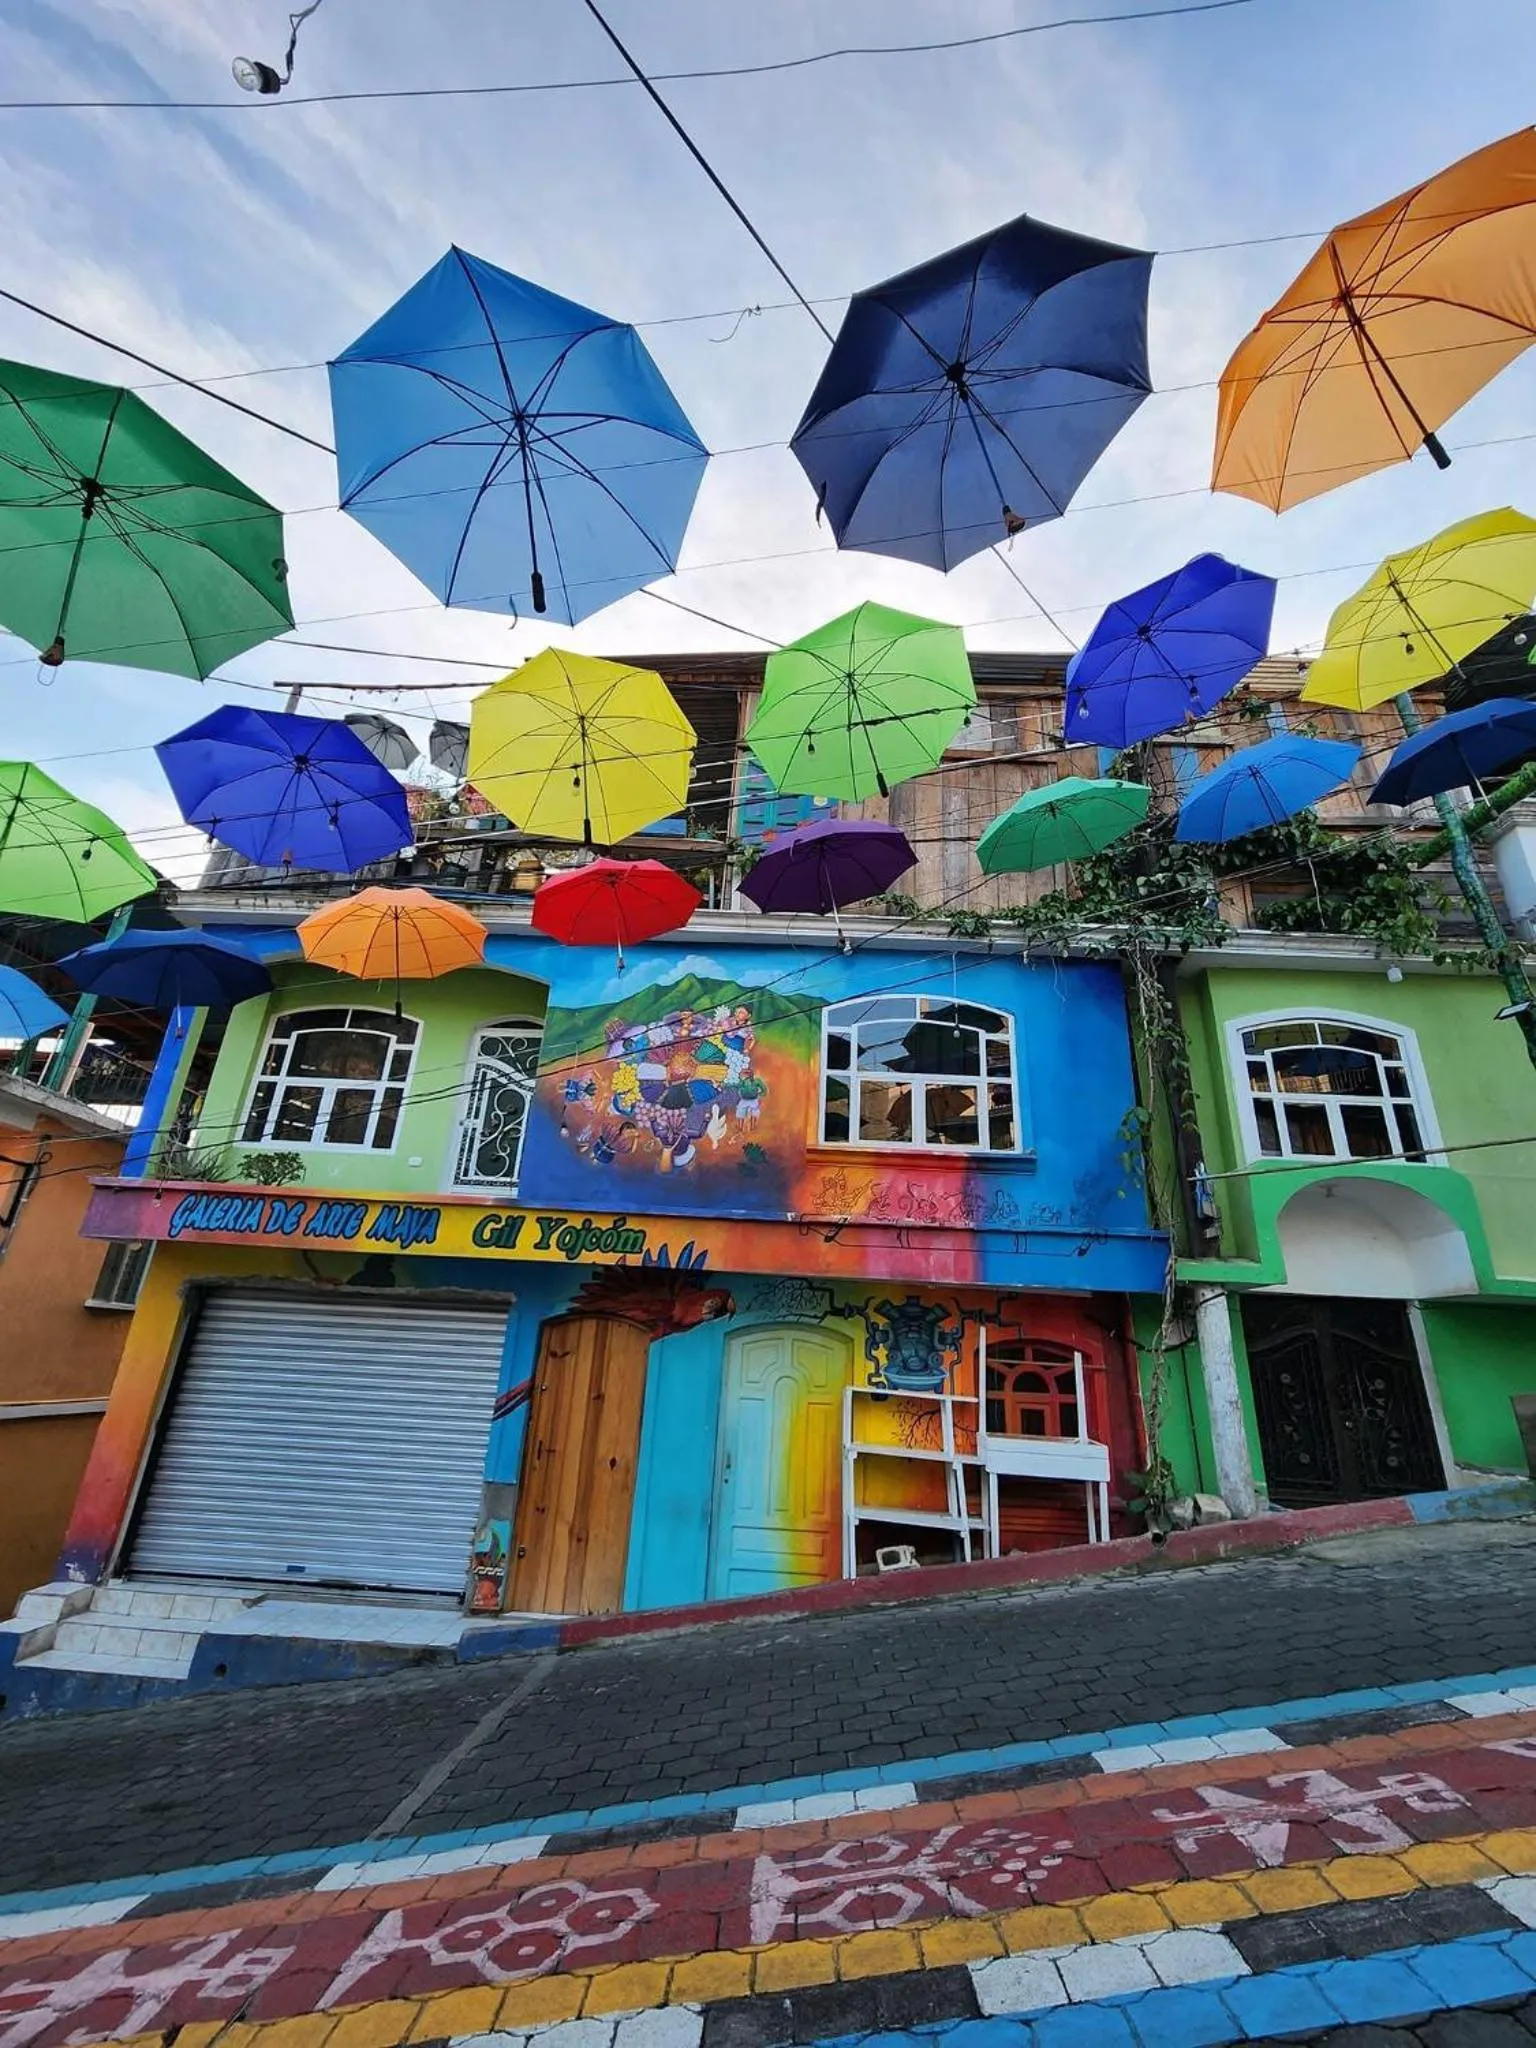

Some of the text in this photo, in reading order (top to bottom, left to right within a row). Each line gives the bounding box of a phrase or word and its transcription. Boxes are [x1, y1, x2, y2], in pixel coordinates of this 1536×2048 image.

[365, 1204, 441, 1249] MAYA
[472, 1213, 646, 1260] Gil Yojcóm
